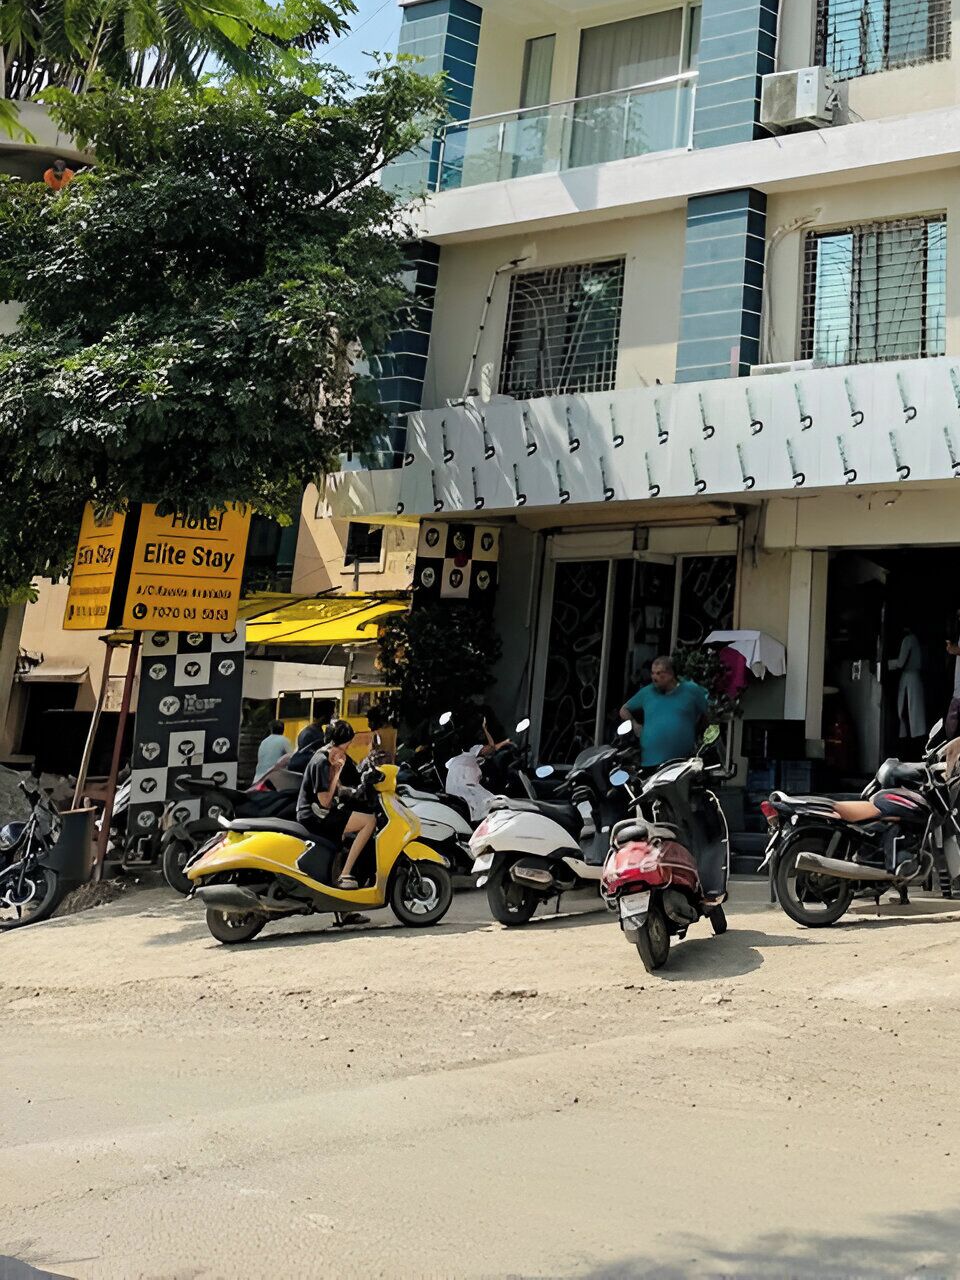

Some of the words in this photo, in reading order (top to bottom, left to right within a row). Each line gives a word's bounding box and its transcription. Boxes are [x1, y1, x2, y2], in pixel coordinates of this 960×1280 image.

[171, 511, 224, 531] Hotel
[144, 542, 186, 565] Elite
[191, 546, 235, 572] Stay
